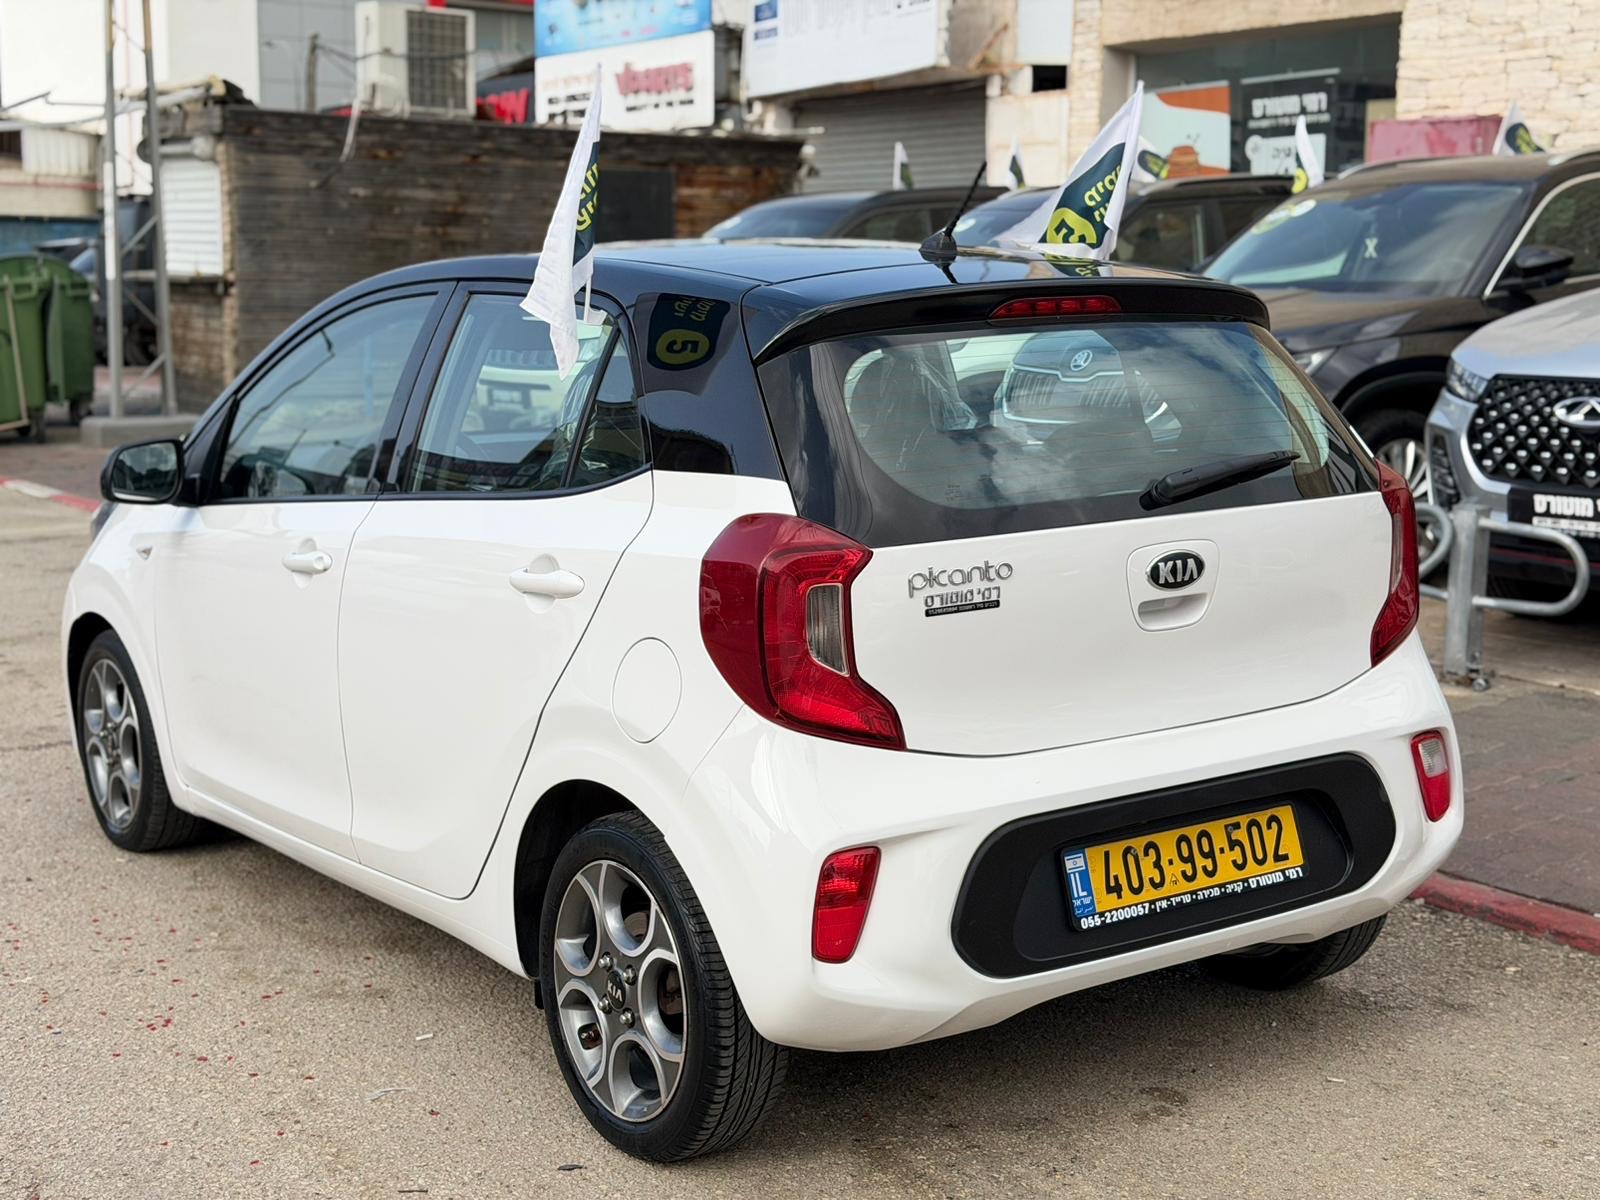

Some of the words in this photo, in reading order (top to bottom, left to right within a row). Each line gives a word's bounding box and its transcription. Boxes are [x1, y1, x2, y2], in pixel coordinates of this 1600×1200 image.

[908, 559, 1013, 599] picanto
[1157, 556, 1200, 584] KIA
[924, 588, 974, 608] מוטורס
[976, 586, 1001, 601] רמי
[1248, 872, 1285, 889] מוטורס
[1284, 866, 1304, 881] רמי
[1070, 872, 1088, 898] IL
[1196, 888, 1221, 902] מכירה
[1225, 882, 1244, 894] קניה
[1080, 902, 1150, 930] 055-2200057
[607, 979, 623, 1002] KIA
